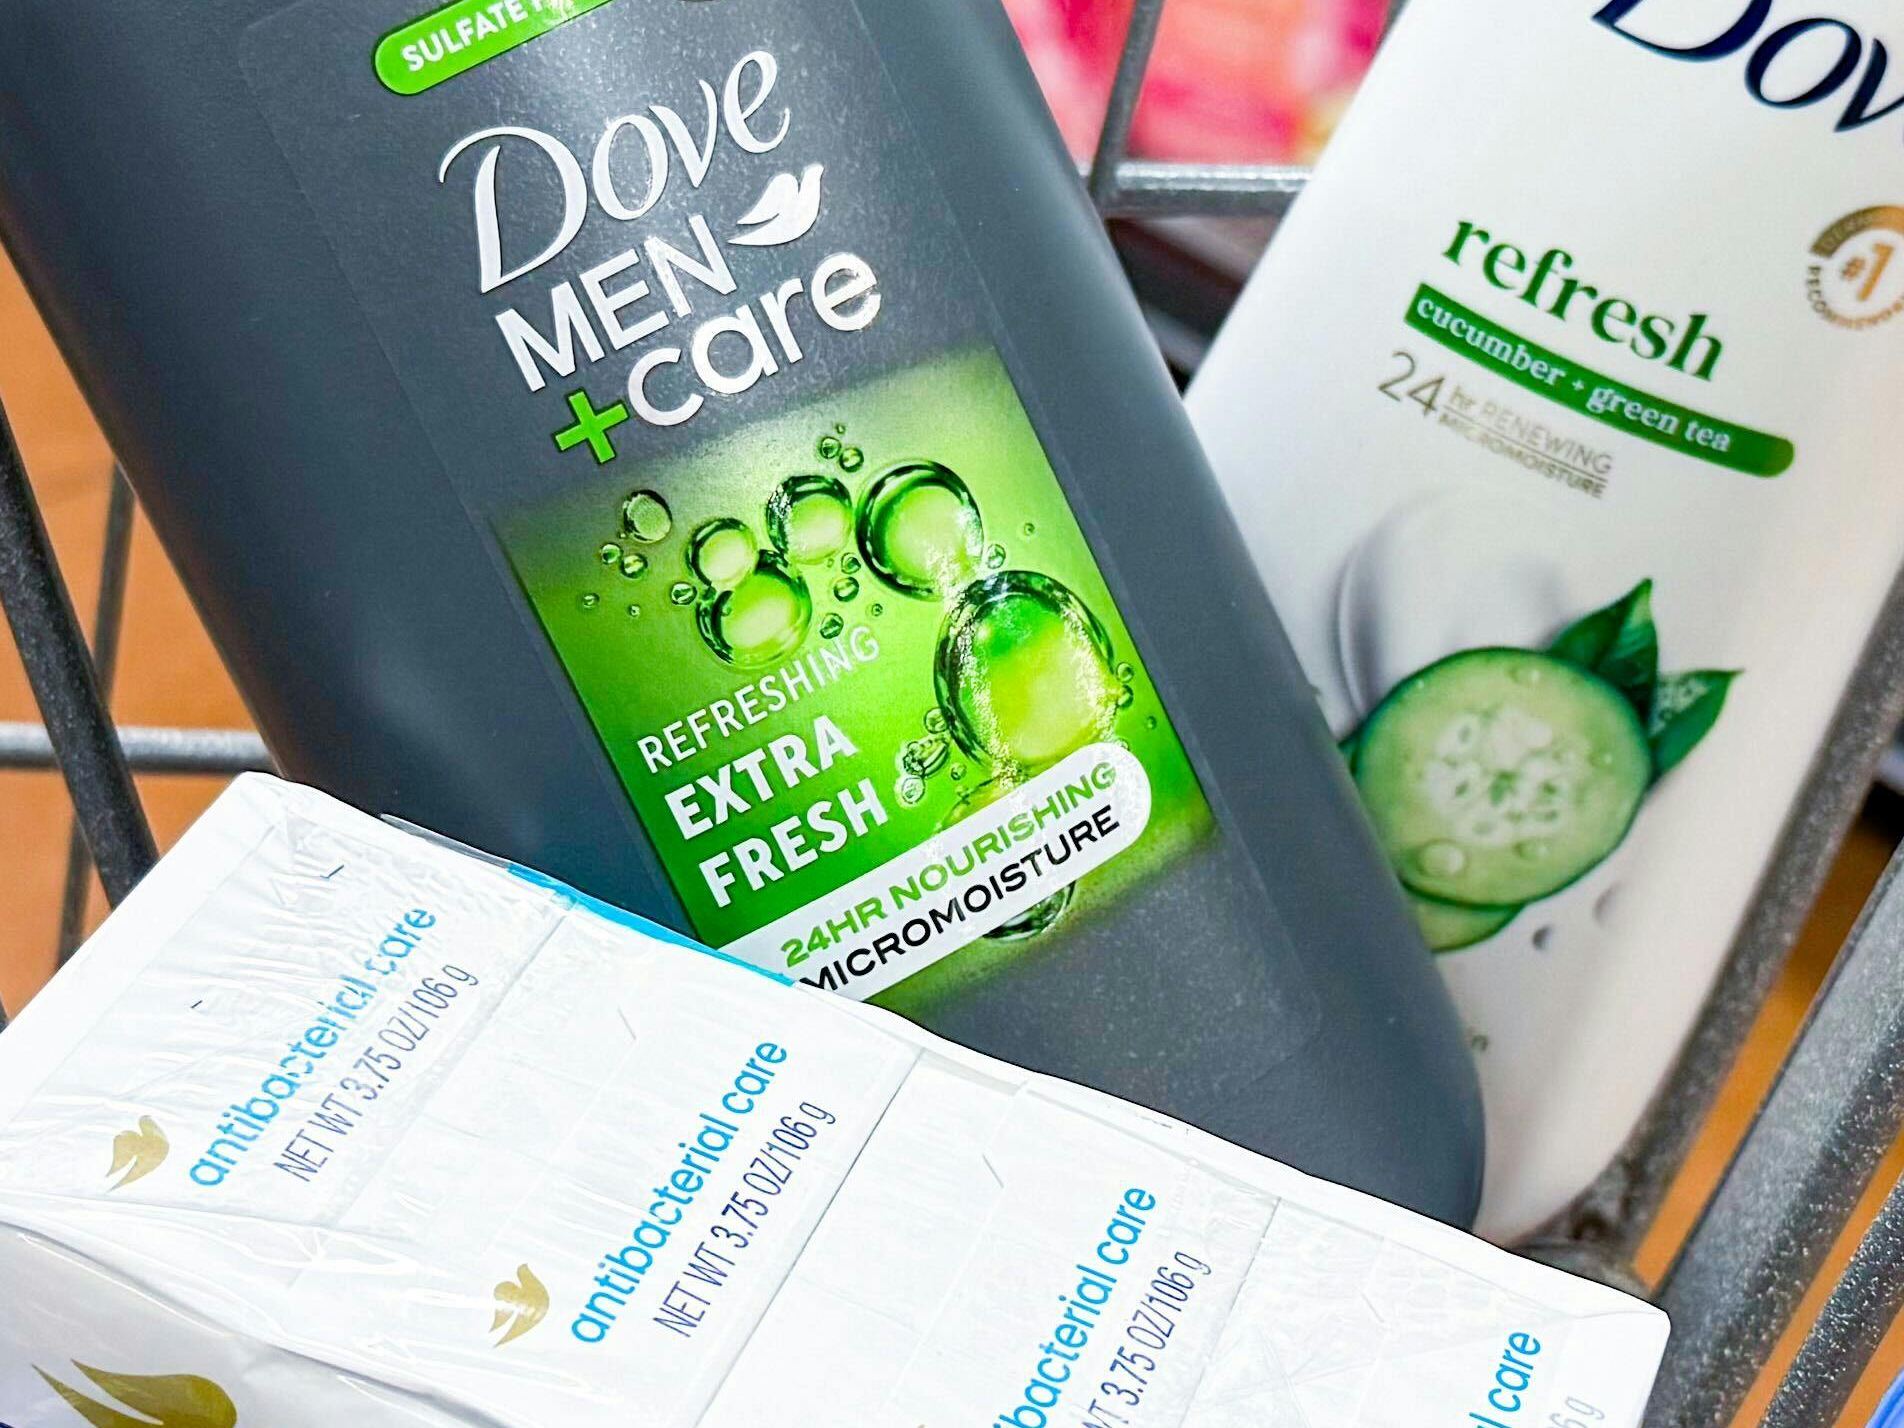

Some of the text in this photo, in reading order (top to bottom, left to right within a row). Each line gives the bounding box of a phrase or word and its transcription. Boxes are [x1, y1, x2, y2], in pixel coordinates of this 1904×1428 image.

[438, 50, 793, 294] Dove
[496, 214, 739, 394] MEN
[1416, 298, 1566, 387] cucumber
[1585, 385, 1679, 435] green
[1685, 420, 1732, 452] tea
[1442, 219, 1723, 381] refresh
[1378, 350, 1445, 417] 24
[1481, 401, 1614, 474] RENEWING
[637, 626, 881, 773] REFRESHING
[664, 714, 859, 841] EXTRA
[698, 777, 889, 908] FRESH
[780, 761, 1118, 968] 24HR NOURISHING
[800, 805, 1120, 994] MICROMOISTURE
[189, 908, 437, 1187] antibacterial care
[273, 964, 480, 1182] NET WT 3.75 OZ/106 g
[571, 1041, 788, 1344] antibacterial care
[652, 1101, 837, 1338] NET WT 3.75 OZ/106 g
[1096, 1187, 1157, 1266] care
[1173, 1251, 1213, 1276] g
[1100, 1346, 1156, 1406] 3.75
[1126, 1266, 1196, 1351] OZ/106
[1487, 1331, 1542, 1413] care
[1563, 1395, 1606, 1422] g
